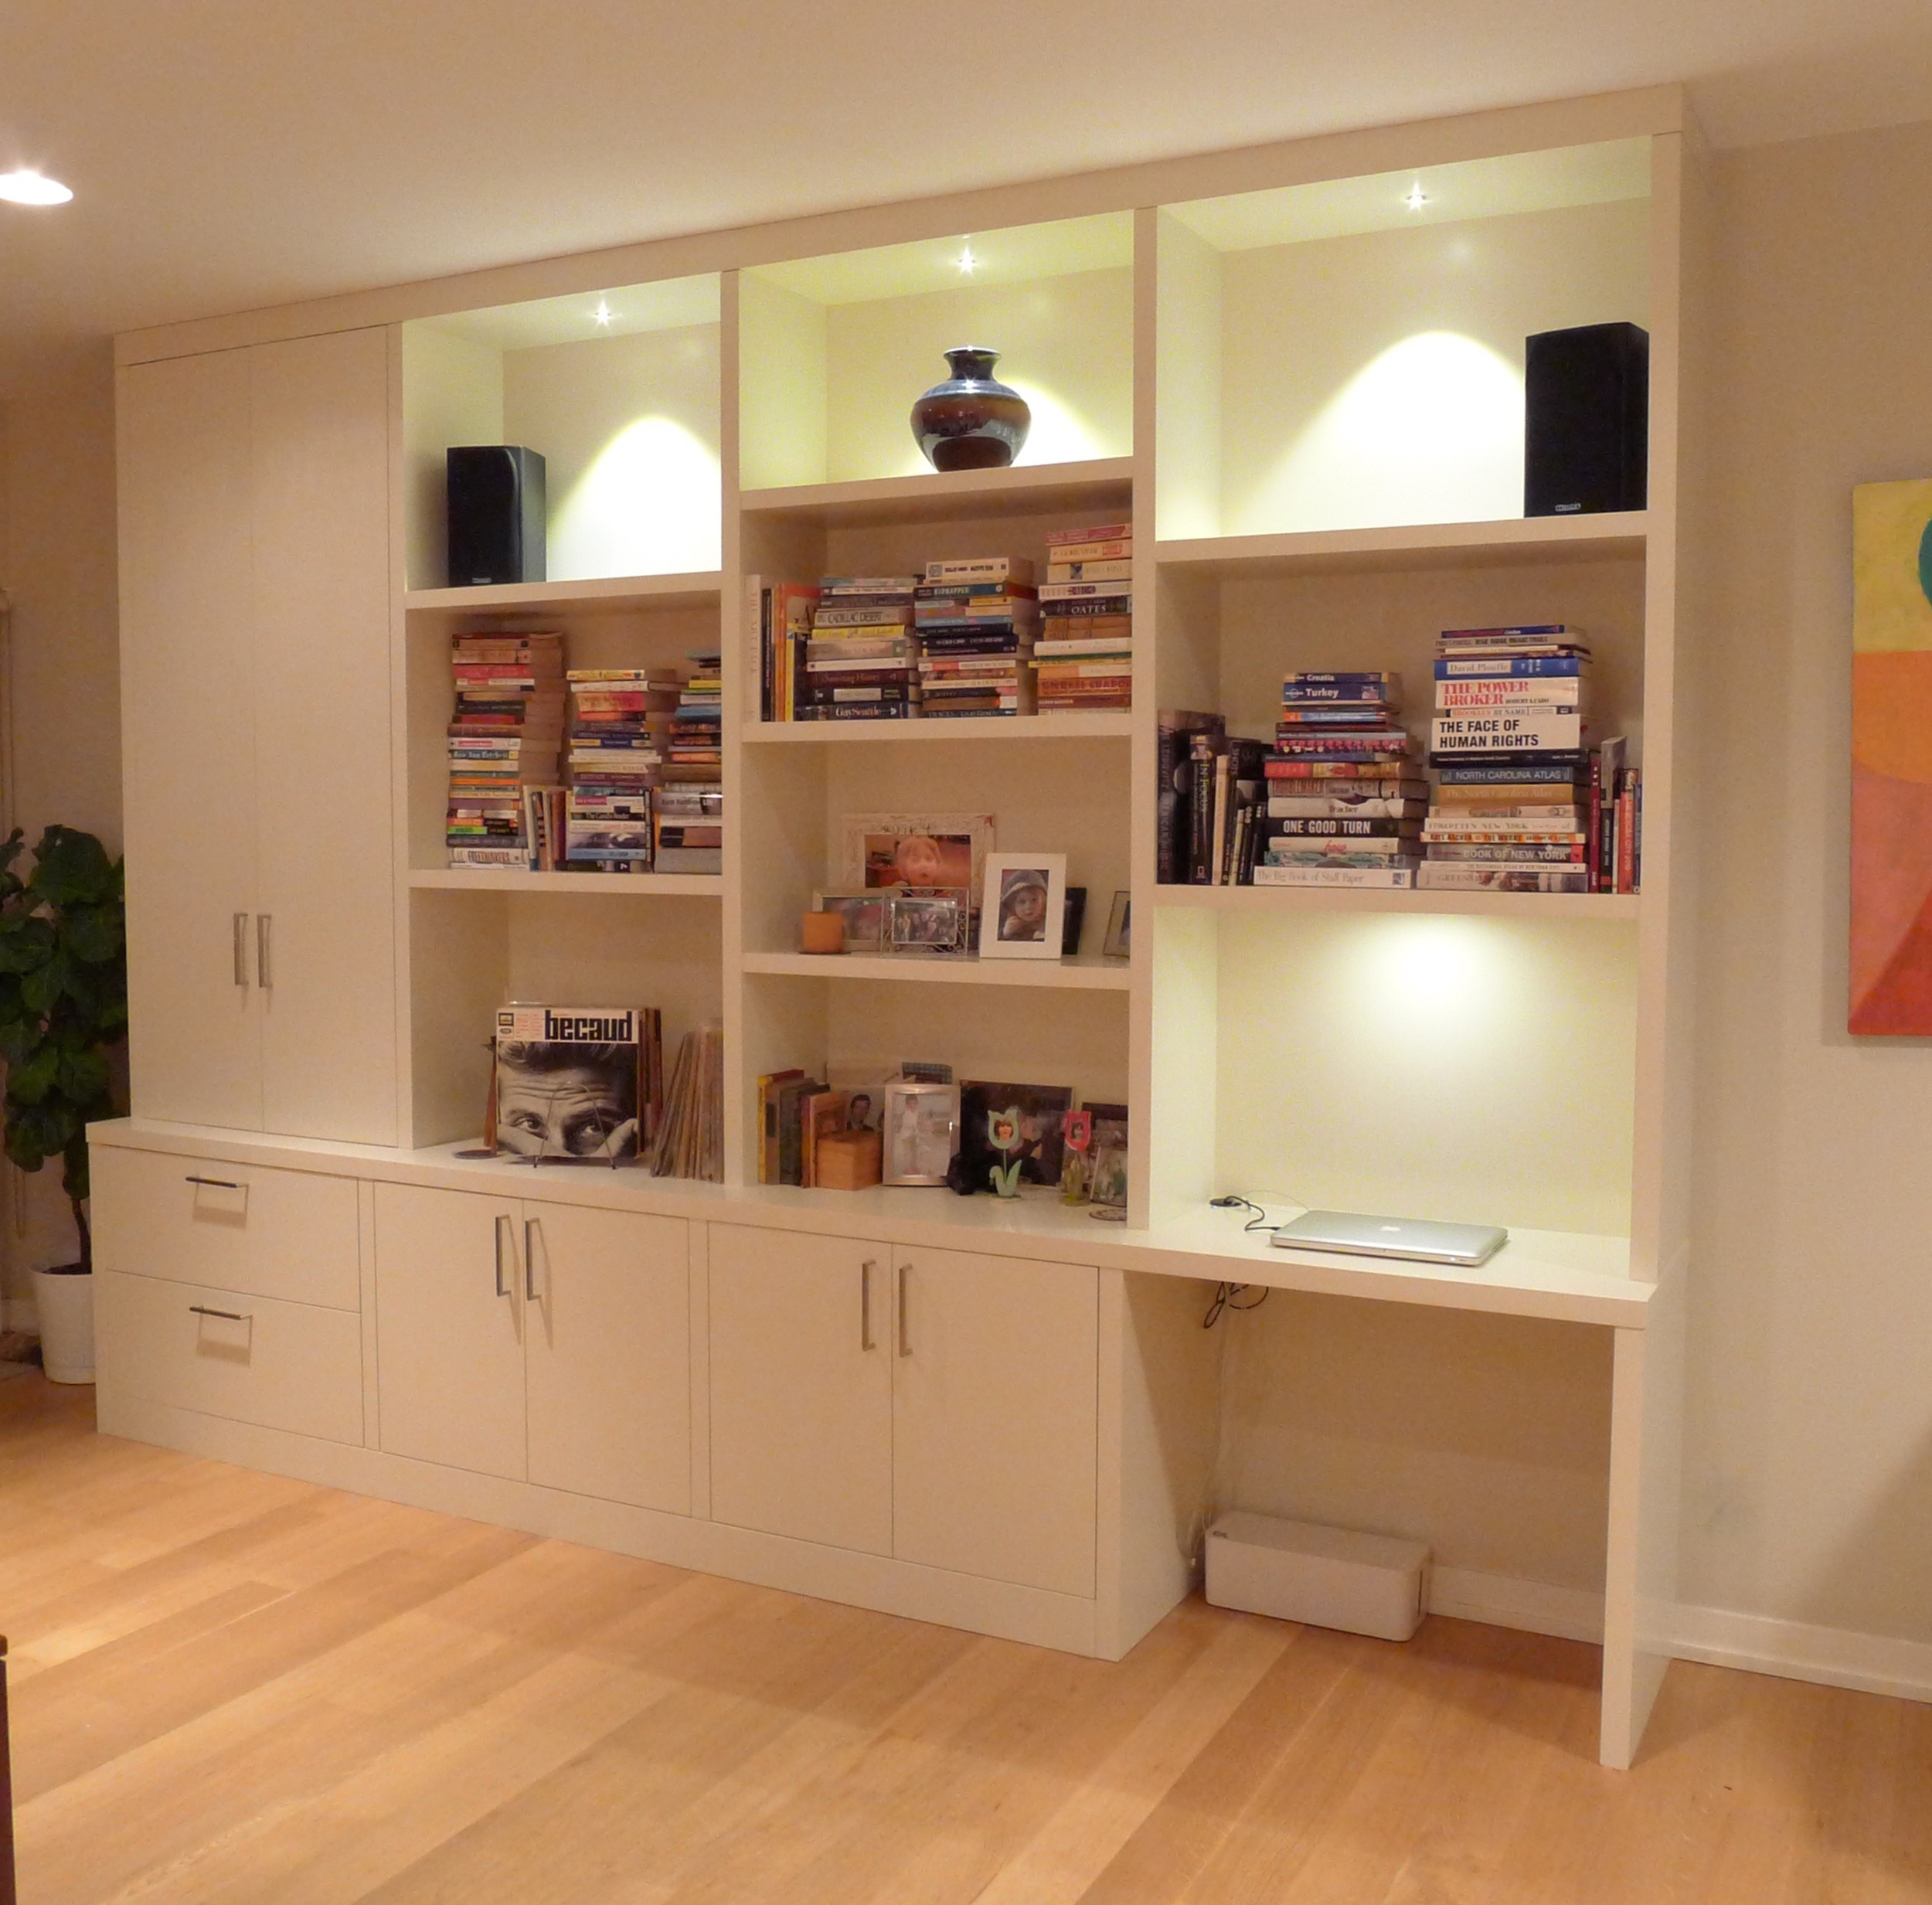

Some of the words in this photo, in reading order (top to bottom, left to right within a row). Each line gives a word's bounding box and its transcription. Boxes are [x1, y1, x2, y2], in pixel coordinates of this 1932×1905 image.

[1071, 604, 1107, 614] OATES
[1450, 663, 1475, 672] David
[1478, 662, 1507, 672] Plouffe
[1305, 687, 1339, 699] Turkey
[1442, 682, 1474, 695] THE
[1477, 681, 1529, 694] POWER
[1444, 694, 1504, 706] BROKER
[1440, 721, 1464, 733] THE
[1468, 719, 1499, 733] FACE
[1503, 719, 1520, 731] OF
[1440, 736, 1487, 748] HUMAN
[1492, 734, 1539, 747] RIGHTS
[1230, 748, 1240, 775] SHOTS
[1199, 764, 1209, 775] IN
[1456, 771, 1485, 780] NORTH
[1488, 771, 1532, 780] CAROLINA
[1534, 770, 1561, 780] ATLAS
[1447, 789, 1459, 798] The
[1464, 789, 1492, 798] North
[1494, 788, 1529, 798] Carolina
[1532, 788, 1552, 797] Atlas
[1328, 805, 1359, 813] Teacher
[1283, 820, 1304, 833] ONE
[1308, 820, 1337, 834] GOOD
[1342, 821, 1371, 834] TURN
[1463, 850, 1492, 859] BOOK
[1495, 850, 1509, 859] OF
[1512, 850, 1536, 859] NEW
[1538, 850, 1566, 860] YORK
[1258, 871, 1271, 879] The
[1274, 871, 1287, 882] Big
[1289, 872, 1307, 880] Book
[1311, 872, 1318, 880] of
[1321, 872, 1339, 881] Staff
[1343, 873, 1364, 883] Paper
[544, 1009, 632, 1042] becaud
